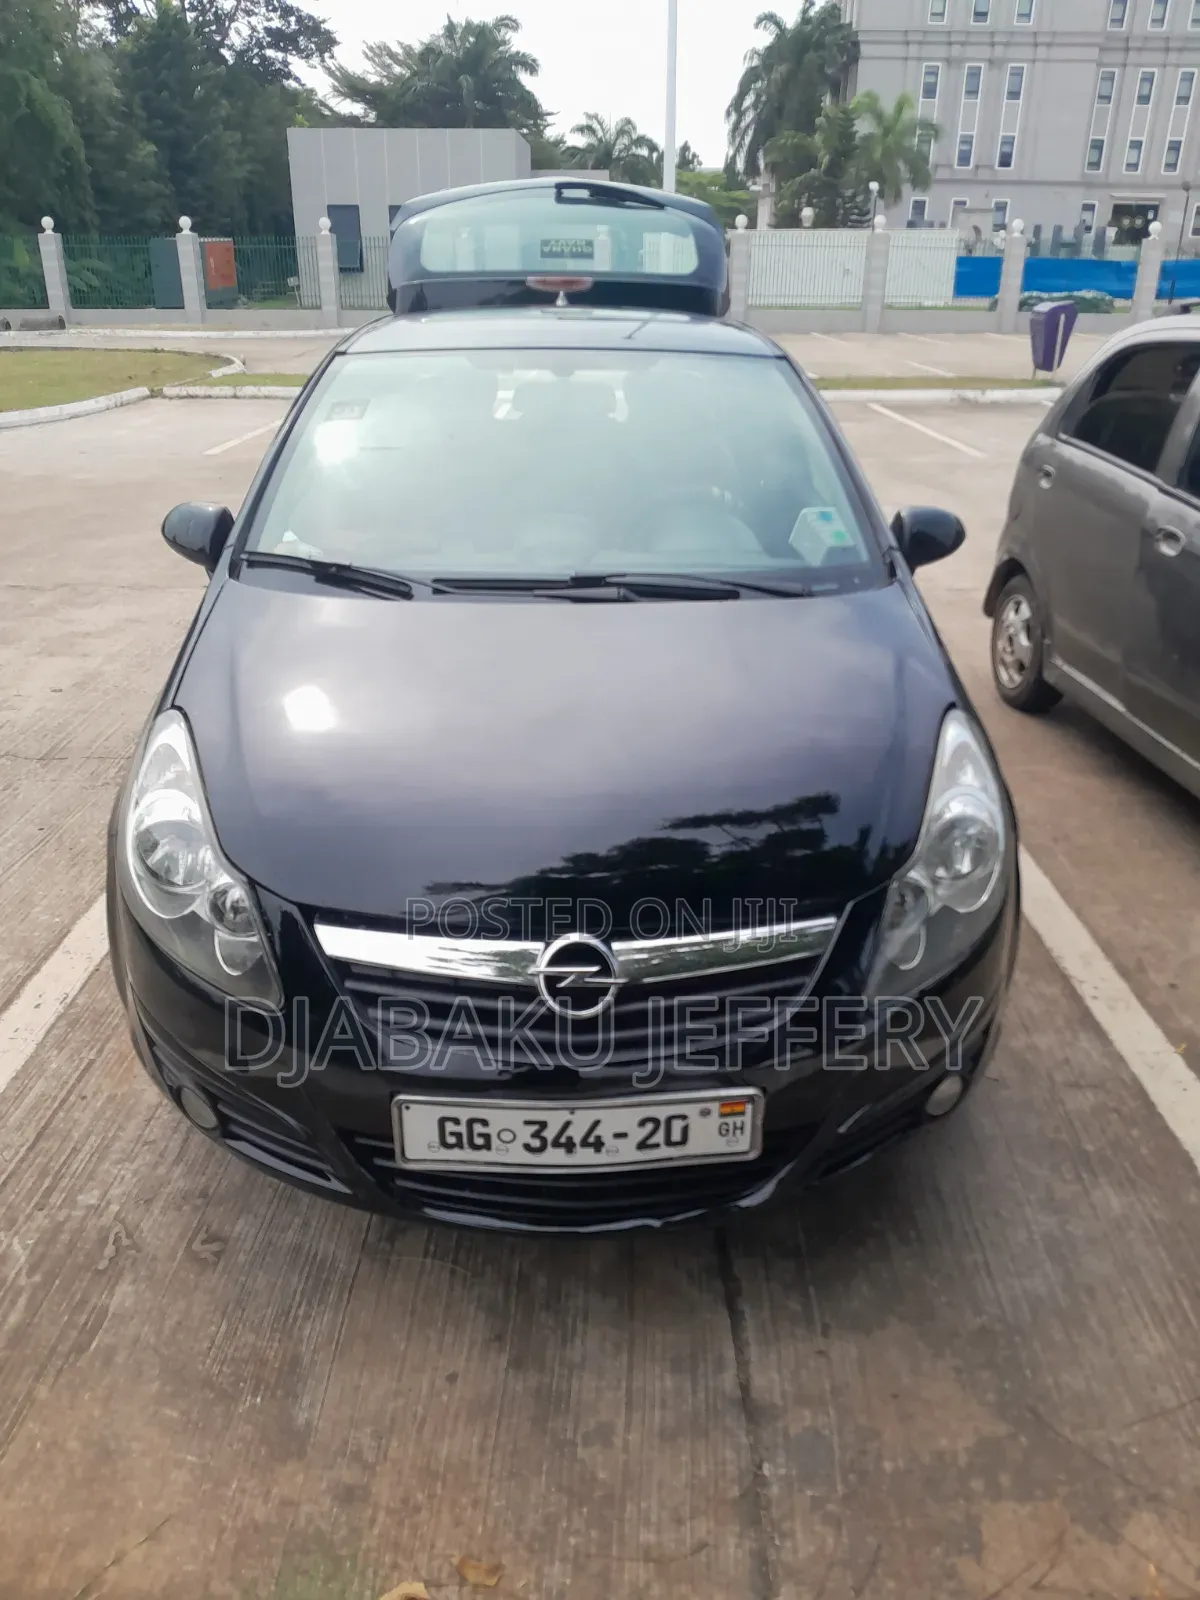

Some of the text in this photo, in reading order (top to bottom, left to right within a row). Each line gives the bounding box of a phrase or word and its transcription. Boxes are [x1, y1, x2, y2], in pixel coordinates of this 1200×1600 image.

[437, 1114, 689, 1154] GG 344-20
[719, 1120, 744, 1137] GH
